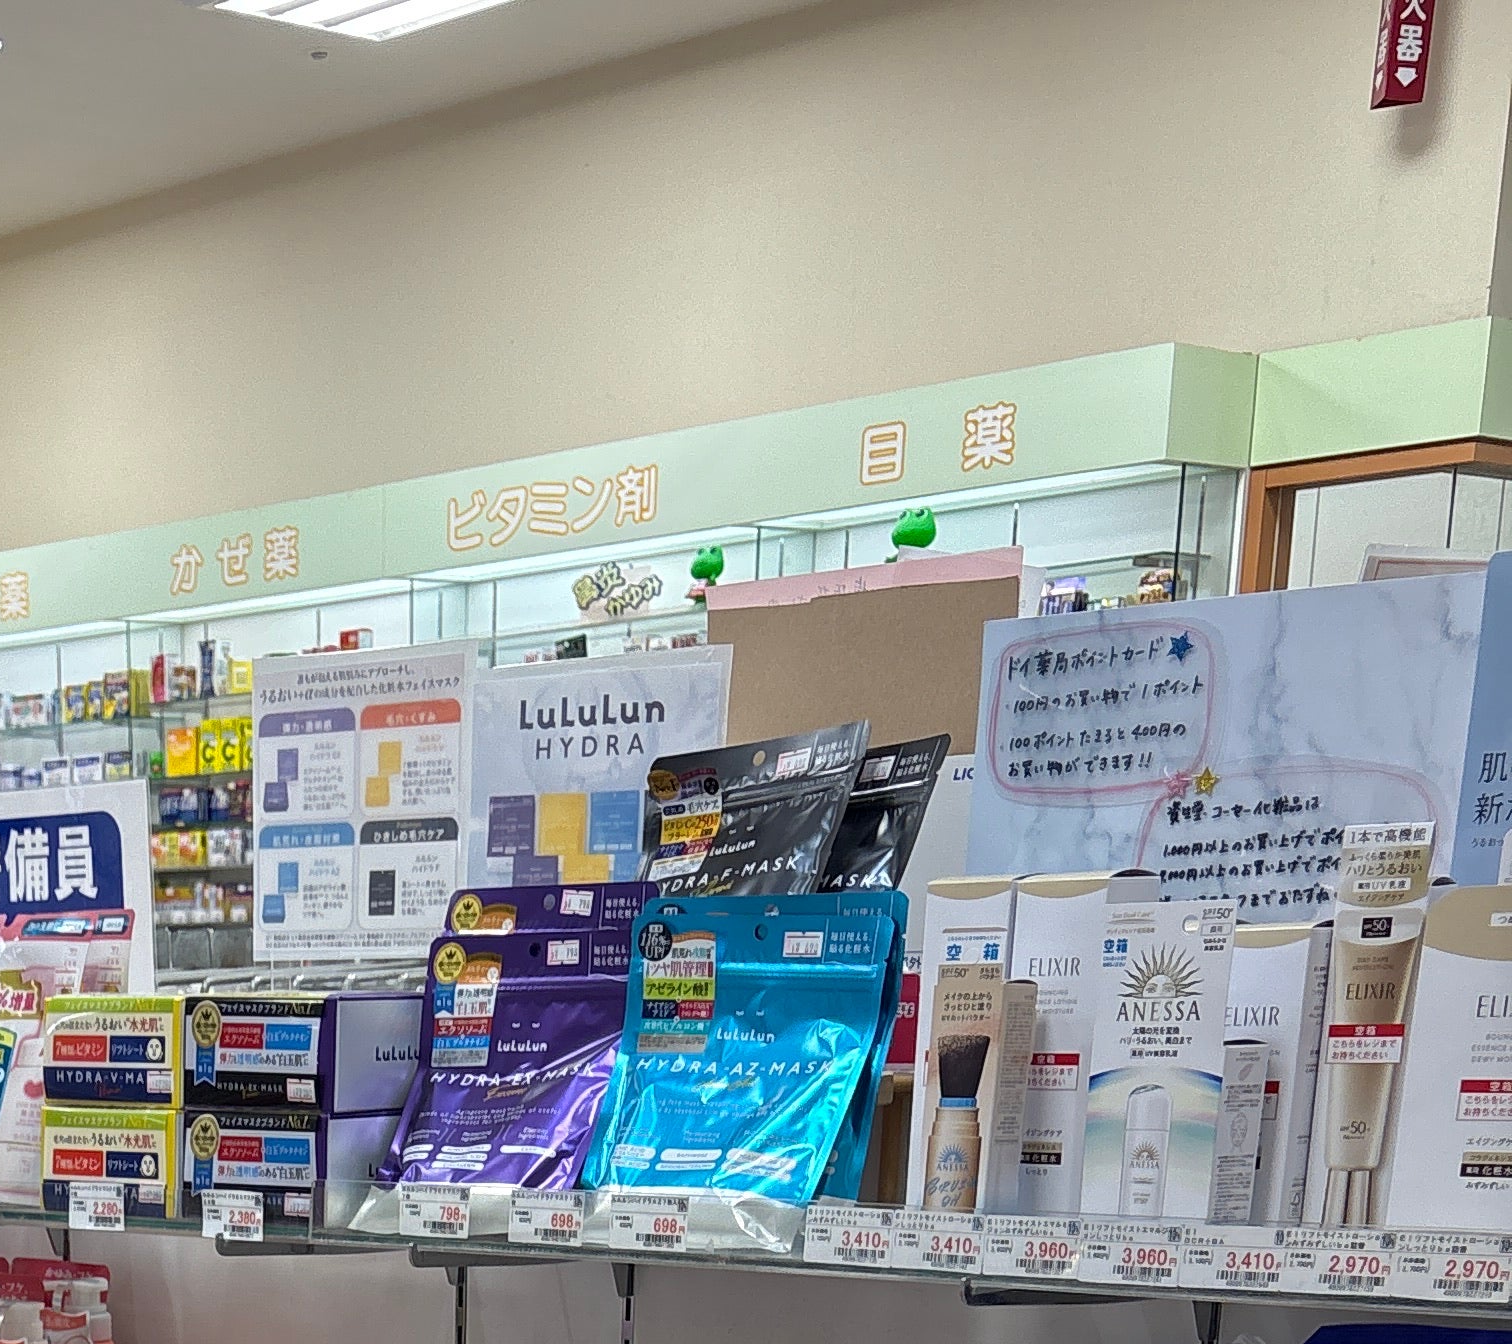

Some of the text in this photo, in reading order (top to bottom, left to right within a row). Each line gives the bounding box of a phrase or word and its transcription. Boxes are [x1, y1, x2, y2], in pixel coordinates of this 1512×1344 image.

[447, 465, 658, 551] ビタミン剤
[520, 694, 666, 730] LuLuLun
[536, 733, 644, 760] HYDRA
[1028, 957, 1081, 977] ELIXIR
[1116, 1000, 1201, 1023] ANESSA
